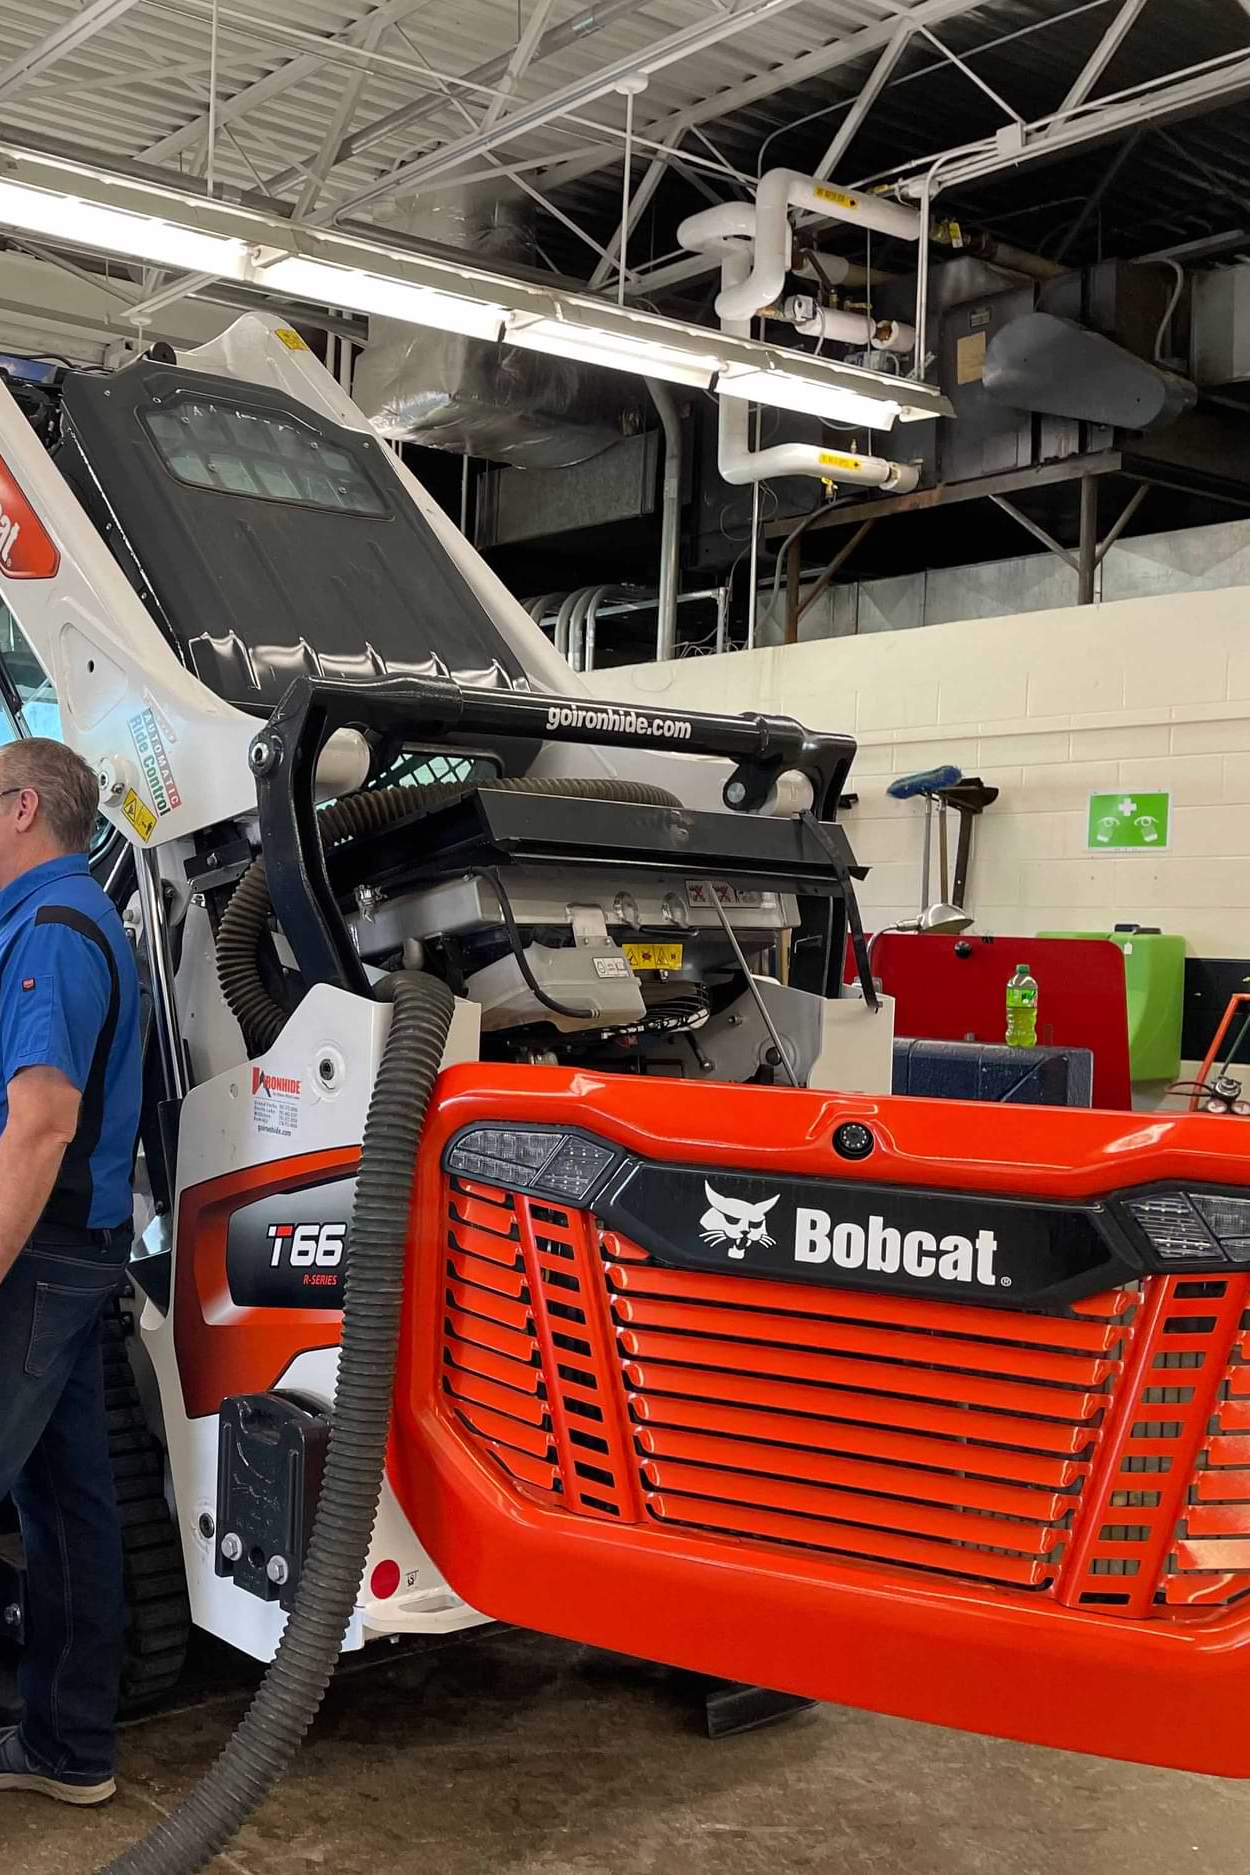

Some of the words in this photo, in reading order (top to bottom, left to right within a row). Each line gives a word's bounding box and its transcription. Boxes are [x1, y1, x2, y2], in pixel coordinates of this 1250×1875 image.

[545, 703, 692, 740] goironhide.com
[129, 714, 149, 753] Ride
[143, 755, 172, 817] Control
[142, 712, 179, 807] AUTOMATIC
[268, 1224, 346, 1266] T66
[794, 1207, 997, 1285] Bobcat
[303, 1274, 337, 1285] R-SERIES
